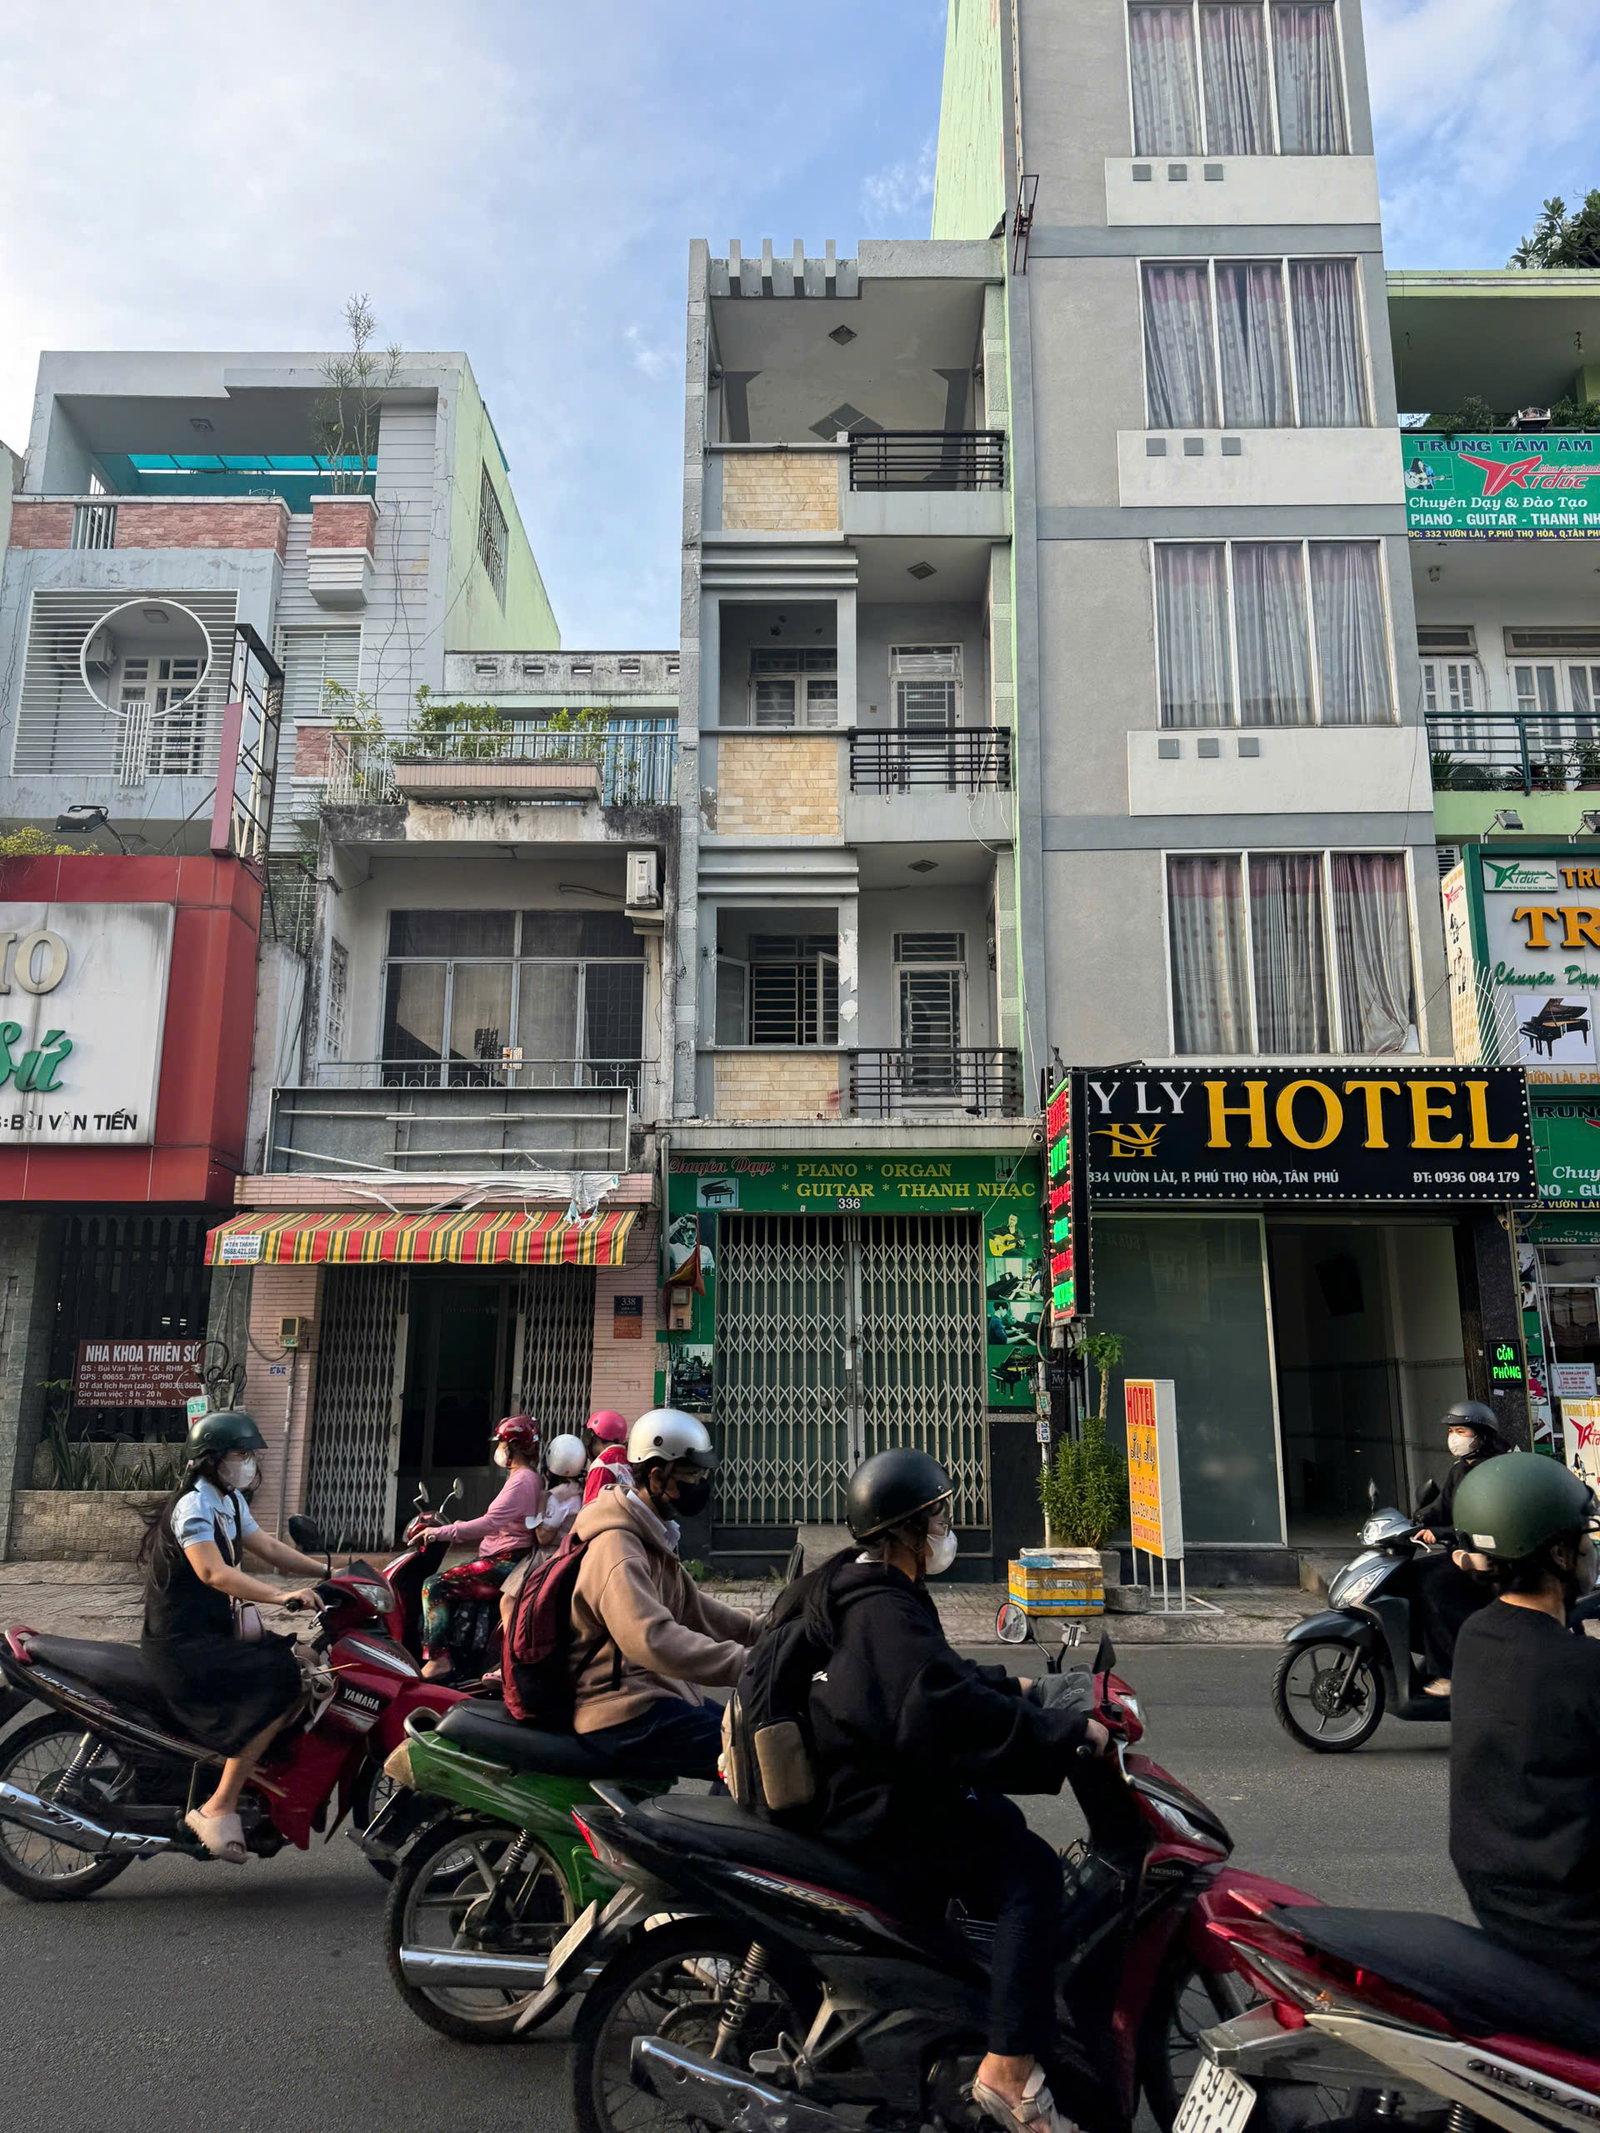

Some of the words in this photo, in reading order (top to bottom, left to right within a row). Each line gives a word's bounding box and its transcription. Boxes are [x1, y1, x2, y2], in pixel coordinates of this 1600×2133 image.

[1413, 439, 1491, 452] TRUNG
[1498, 437, 1549, 452] TÂM
[1556, 437, 1593, 452] ÂM
[1409, 497, 1467, 510] Chuyên
[1470, 497, 1501, 510] Dạy
[1504, 498, 1519, 508] &
[1523, 497, 1554, 508] Đào
[1558, 498, 1588, 509] Tạo
[1411, 513, 1453, 525] PIANO
[1466, 513, 1517, 525] GUITAR
[1531, 513, 1579, 525] THANH
[1425, 530, 1441, 538] 332
[1443, 528, 1467, 538] VƯỜN
[1469, 528, 1485, 540] LÀI,
[1488, 528, 1514, 538] P.PHÚ
[1516, 530, 1534, 540] THỌ
[1537, 528, 1557, 540] HÒA,
[1559, 528, 1585, 539] Q.TÂN
[93, 1108, 138, 1131] TIẾN
[1134, 1081, 1192, 1114] LY
[1203, 1079, 1519, 1150] HOTEL
[796, 1163, 858, 1177] PIANO
[881, 1163, 952, 1177] ORGAN
[1113, 1168, 1150, 1183] VƯỜN
[1153, 1168, 1178, 1185] LÀI,
[1194, 1168, 1219, 1183] PHÚ
[1222, 1171, 1248, 1186] THỌ
[1313, 1168, 1339, 1183] PHÚ
[1413, 1171, 1433, 1183] ĐT:
[1435, 1171, 1466, 1183] 0936
[1469, 1171, 1496, 1183] 084
[1497, 1171, 1520, 1183] 179
[796, 1183, 875, 1197] GUITAR
[897, 1183, 970, 1197] THANH
[977, 1183, 1036, 1200] NHẠC
[838, 1198, 861, 1210] 336
[1548, 1199, 1579, 1209] VƯỜN
[85, 1345, 110, 1362] NHA
[113, 1345, 144, 1362] KHOA
[147, 1342, 181, 1362] THIÊN
[1496, 1344, 1514, 1360] CÒN
[1492, 1362, 1522, 1379] PHÒNG
[1126, 1387, 1156, 1427] HOTEL
[344, 1688, 380, 1711] YAMAHA
